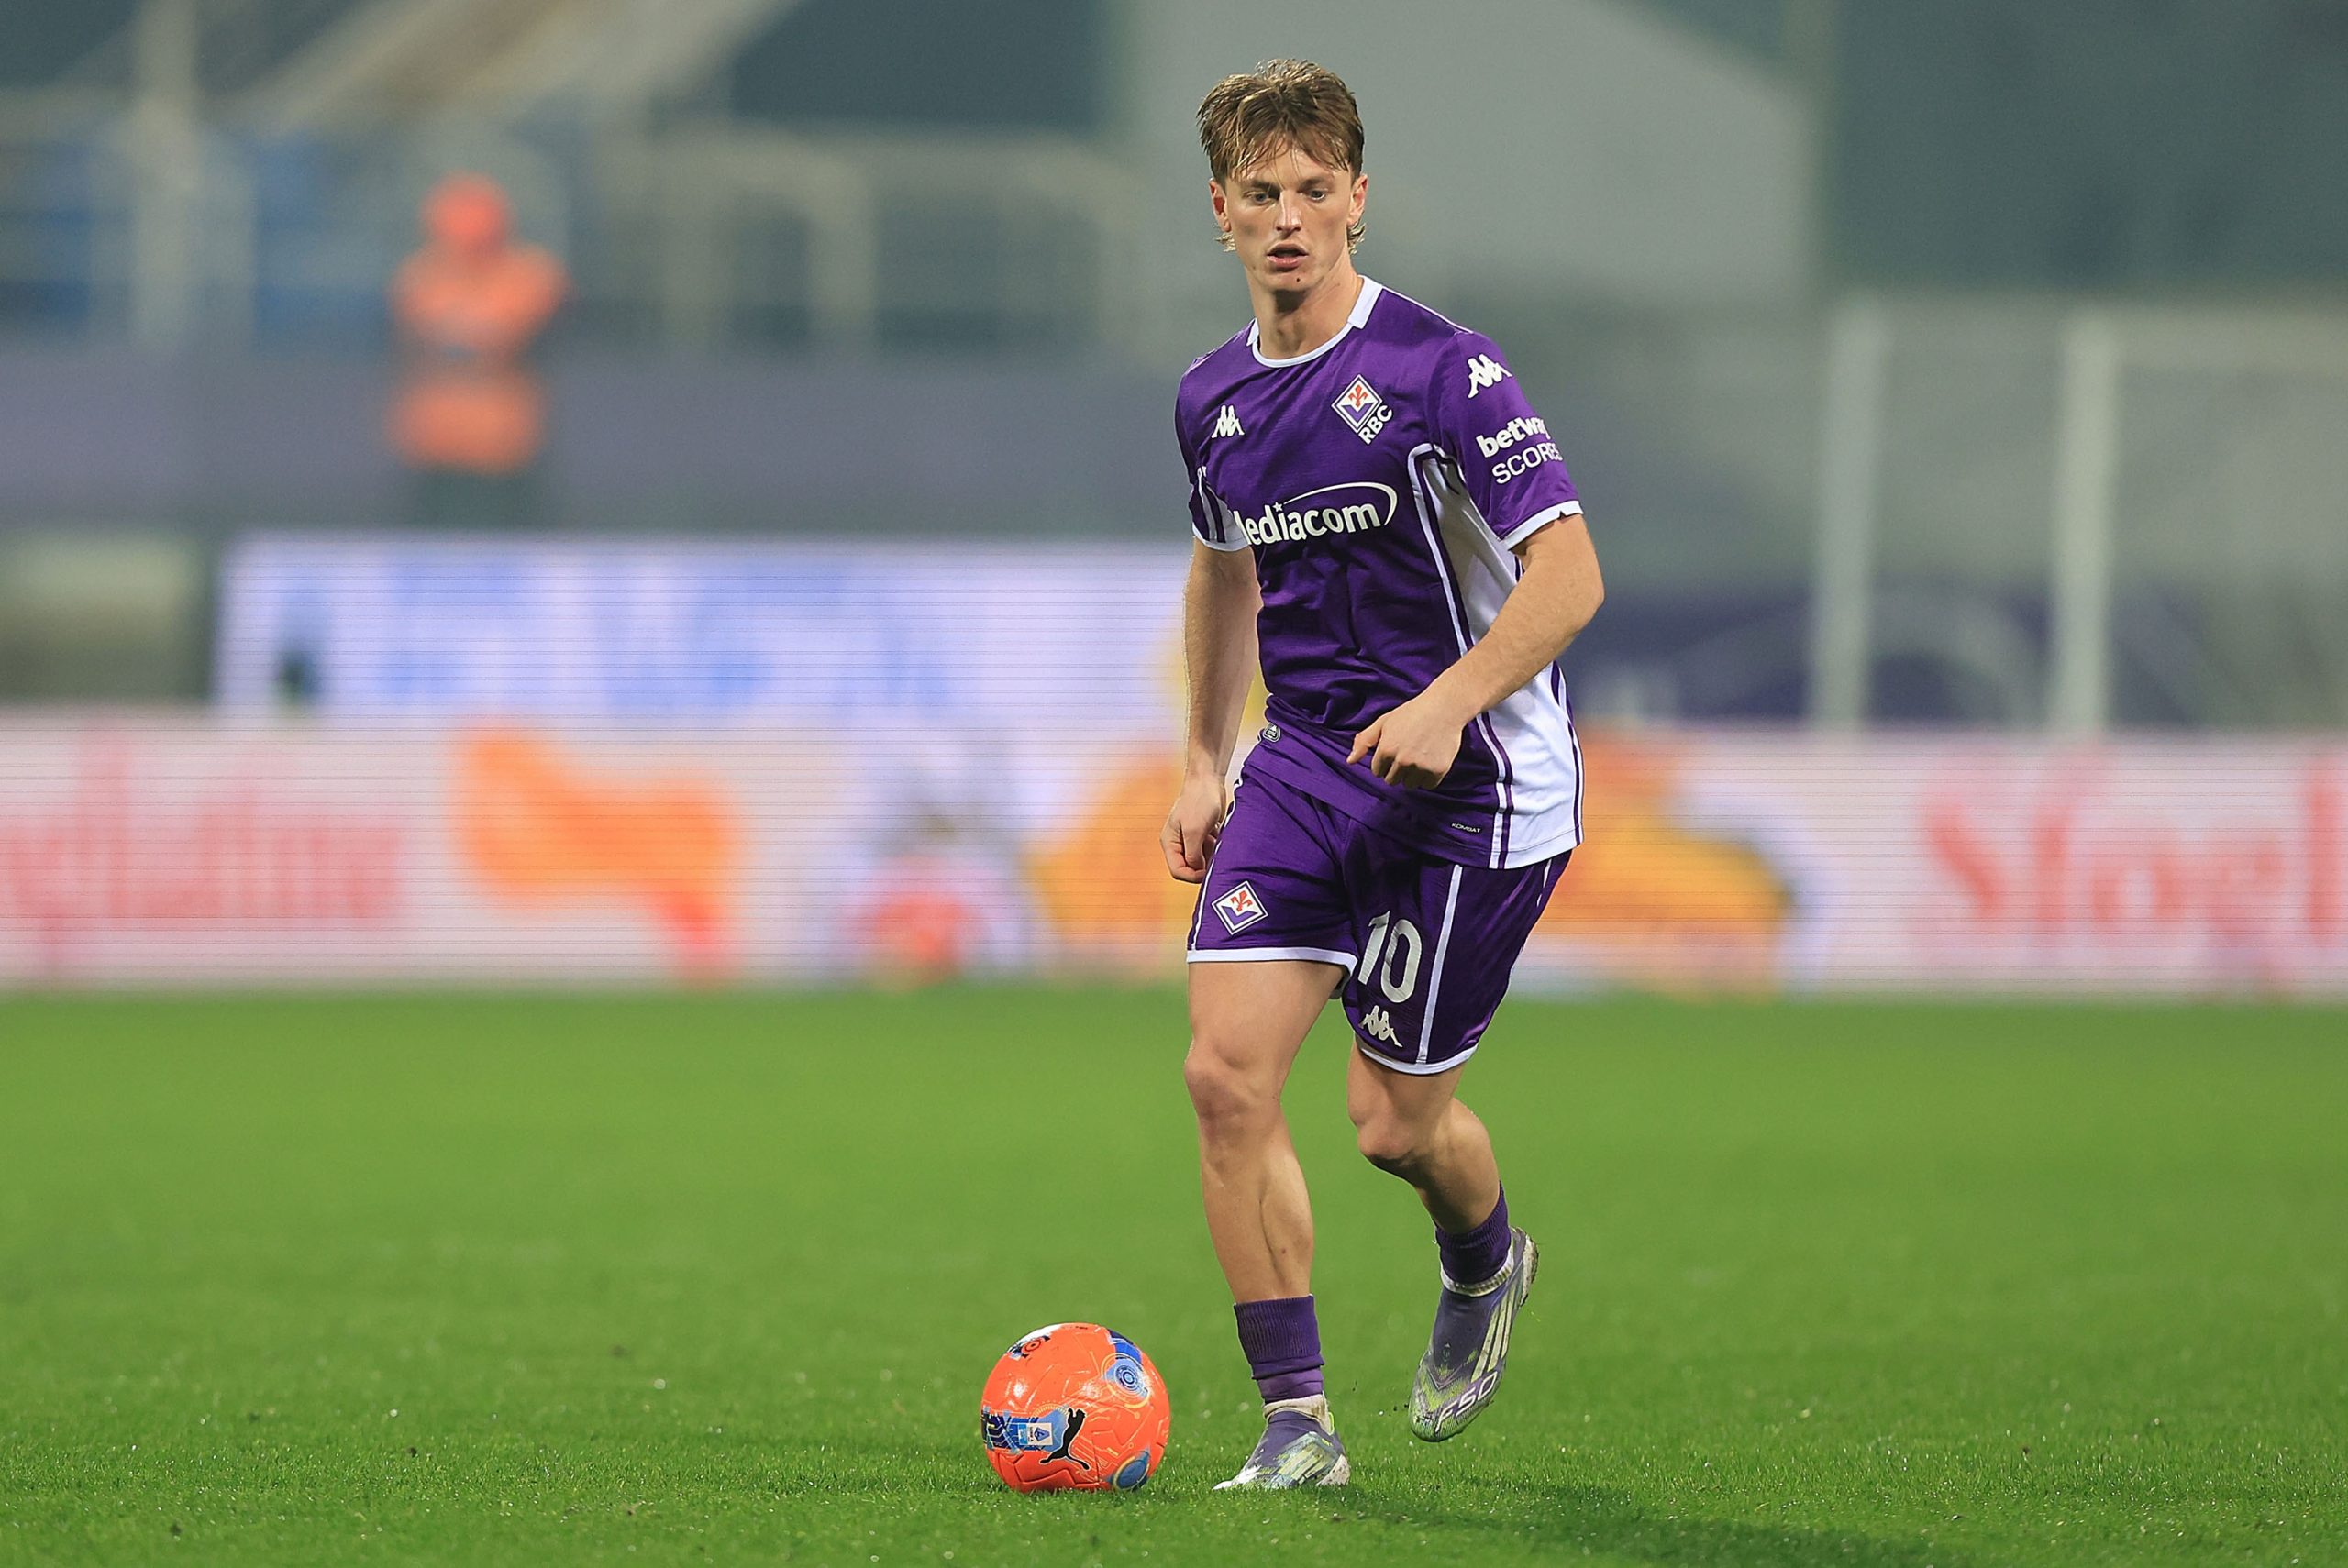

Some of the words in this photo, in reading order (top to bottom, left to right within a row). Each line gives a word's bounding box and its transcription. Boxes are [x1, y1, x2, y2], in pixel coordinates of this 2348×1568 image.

[1358, 405, 1392, 445] RBC
[1358, 911, 1422, 1003] 10
[1435, 1371, 1498, 1432] F50
